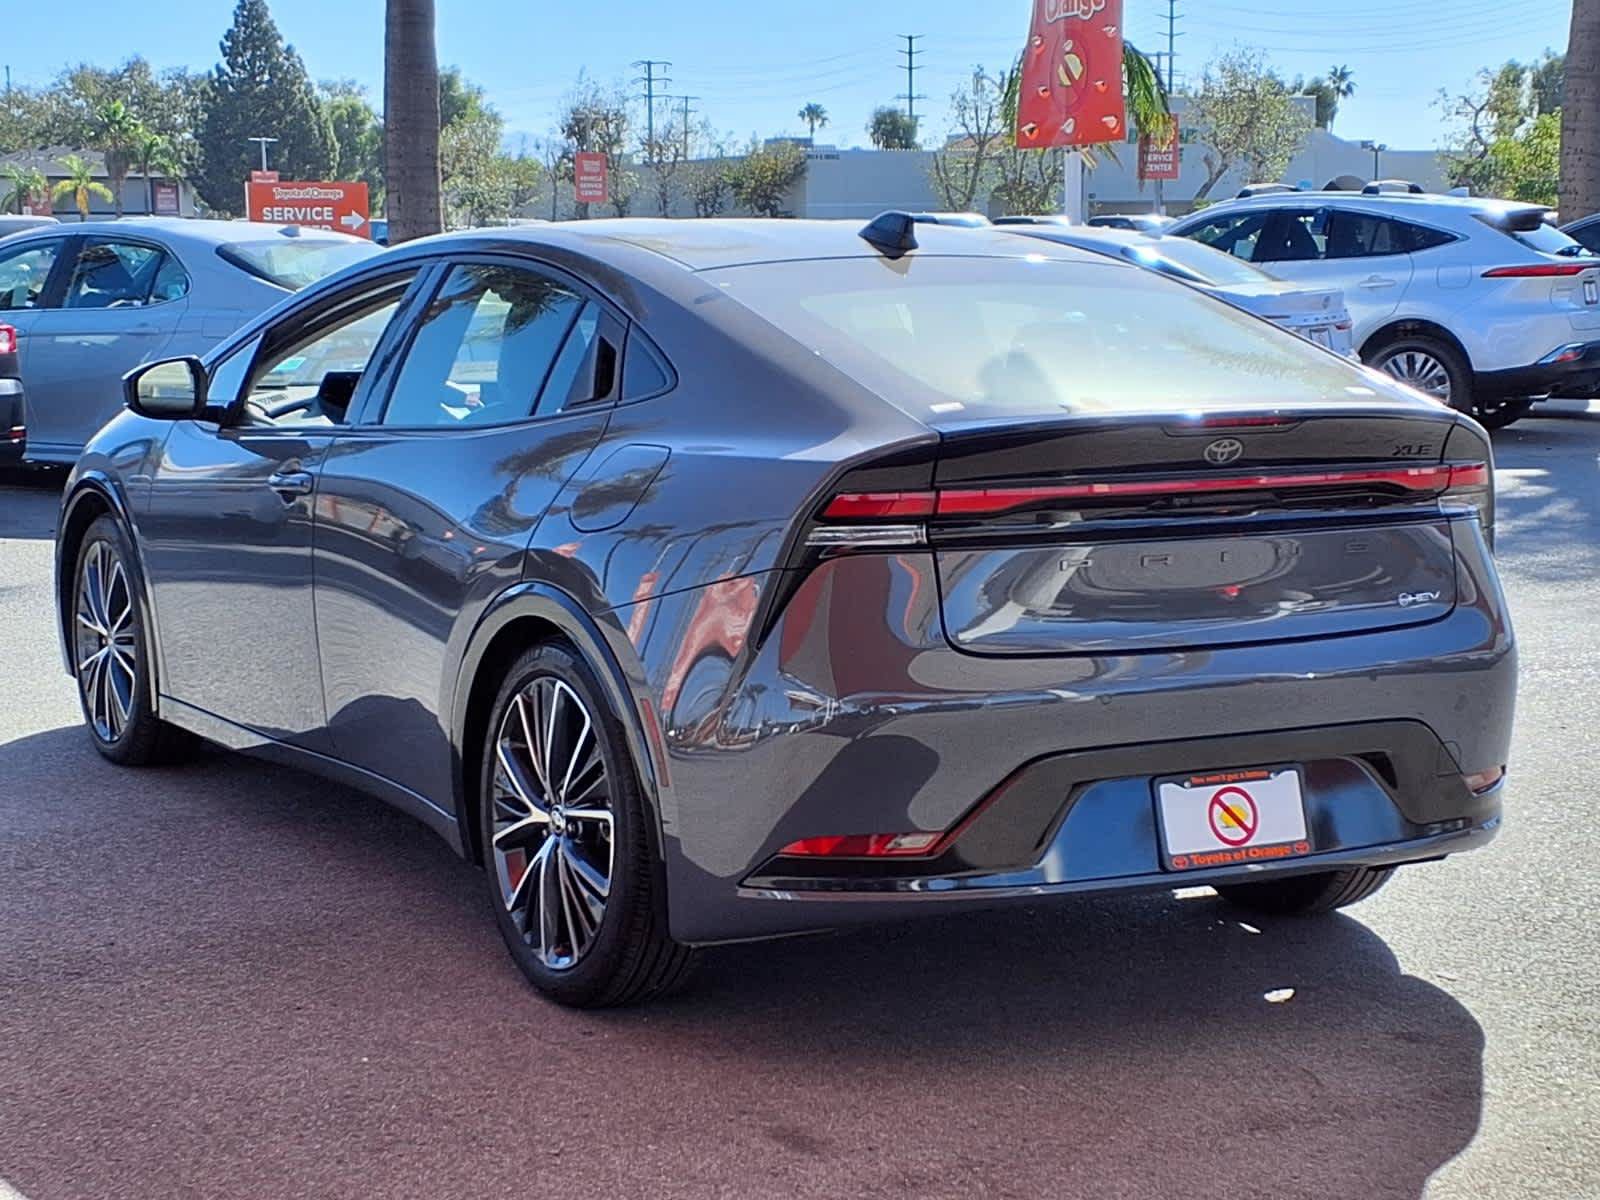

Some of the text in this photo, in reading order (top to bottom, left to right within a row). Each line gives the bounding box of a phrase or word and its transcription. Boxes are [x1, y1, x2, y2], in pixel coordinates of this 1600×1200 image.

[263, 206, 334, 221] SERVICE
[1392, 444, 1432, 456] XLE
[1190, 845, 1292, 865] Toyota of Orange
